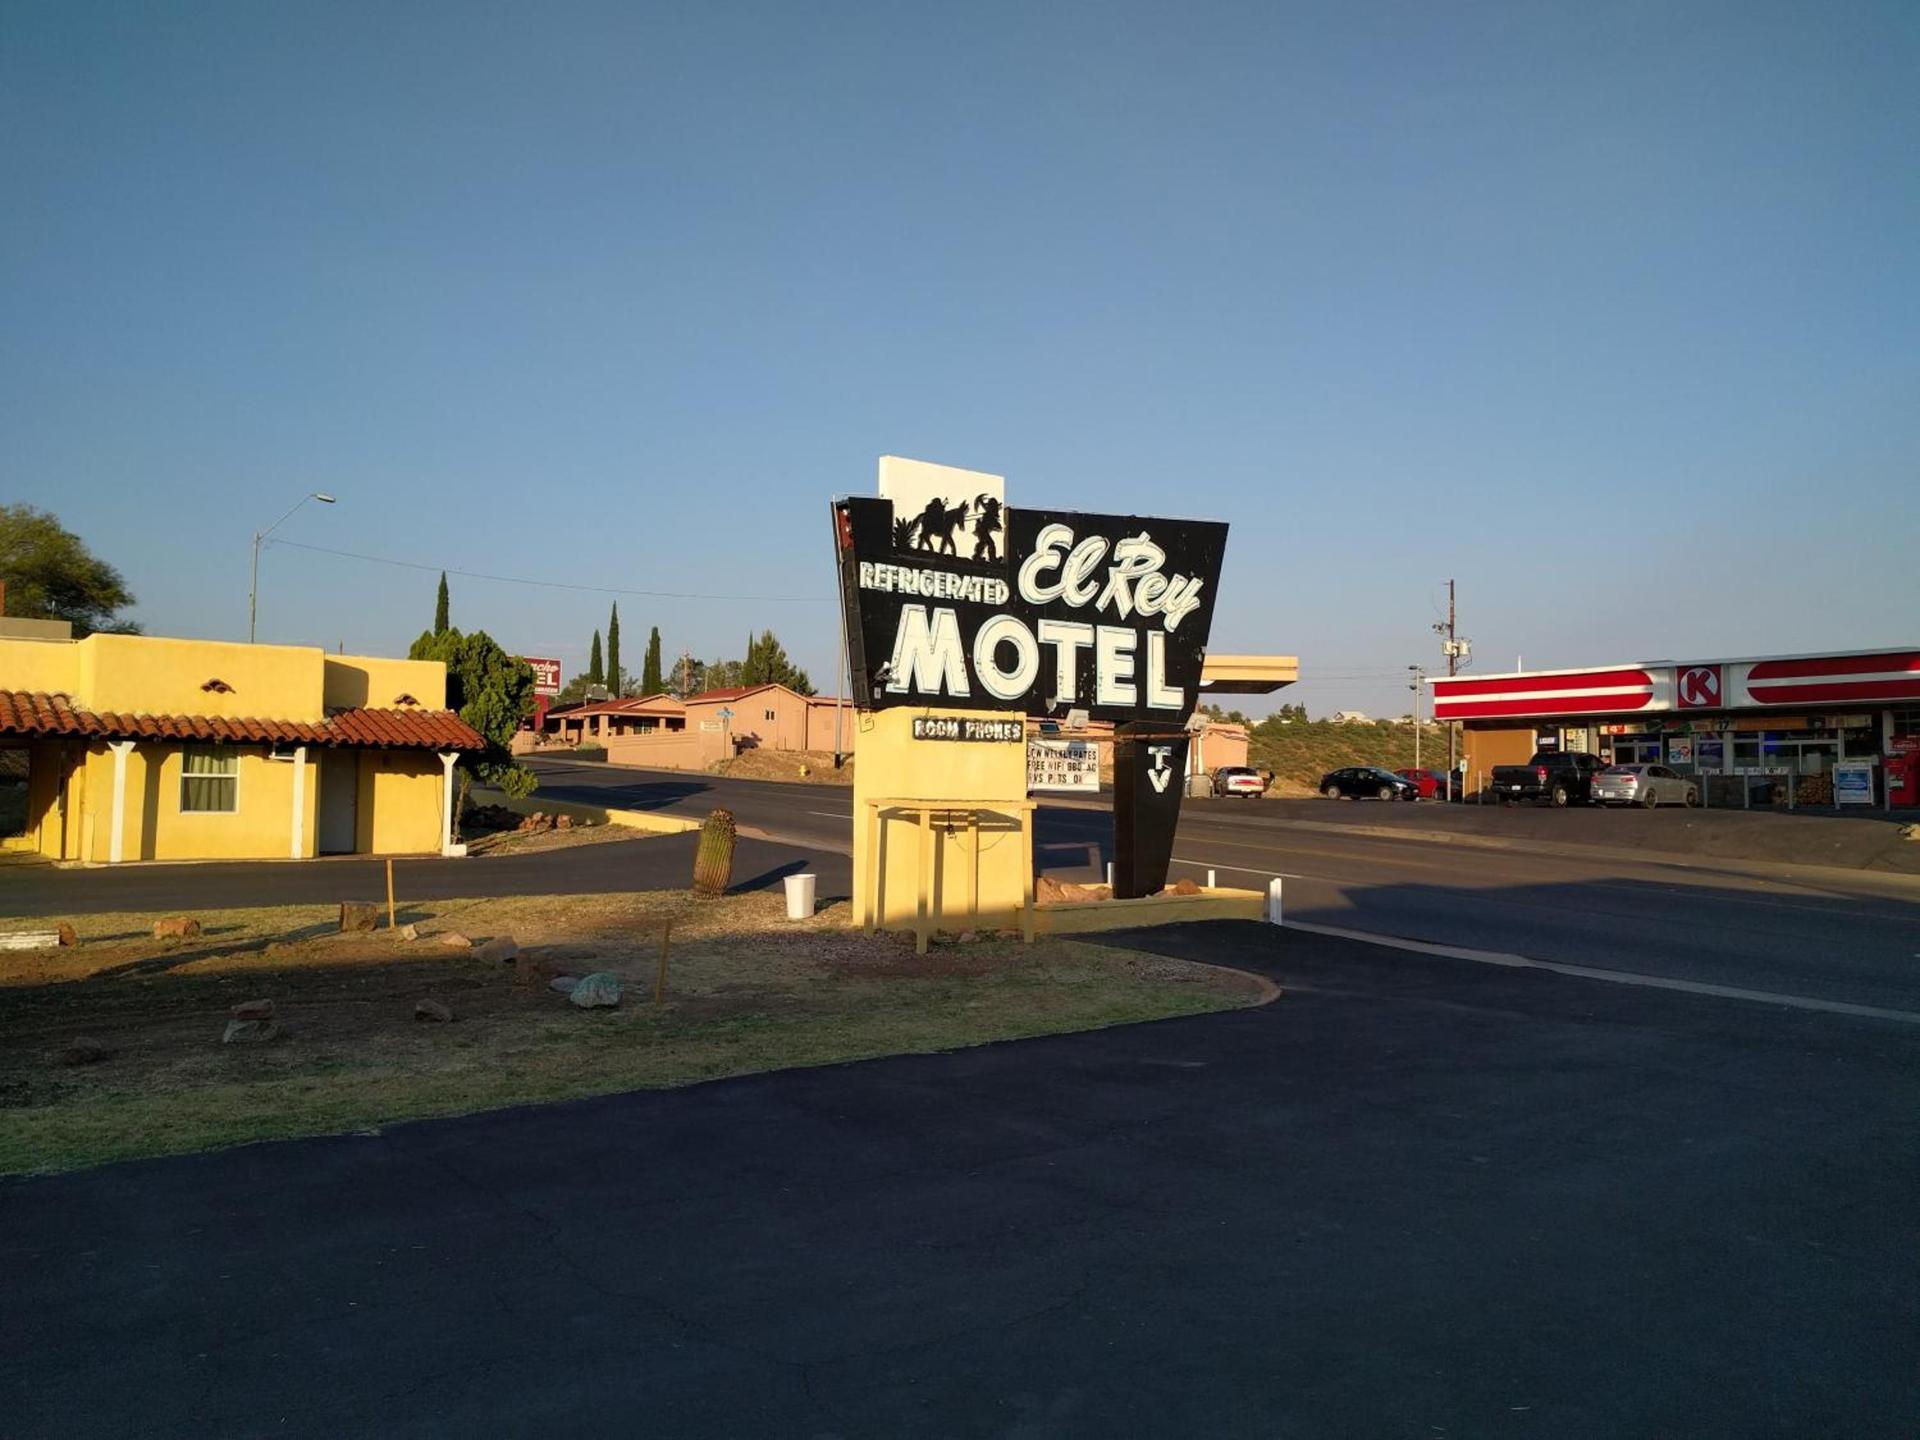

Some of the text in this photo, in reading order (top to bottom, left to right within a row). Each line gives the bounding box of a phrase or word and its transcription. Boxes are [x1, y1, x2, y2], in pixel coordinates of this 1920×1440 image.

[859, 561, 1010, 605] REFRIGERATED
[1018, 523, 1204, 633] El Rey
[885, 603, 1185, 710] MOTEL
[1686, 669, 1718, 705] K
[915, 720, 959, 737] ROOM
[1048, 774, 1067, 784] PTS
